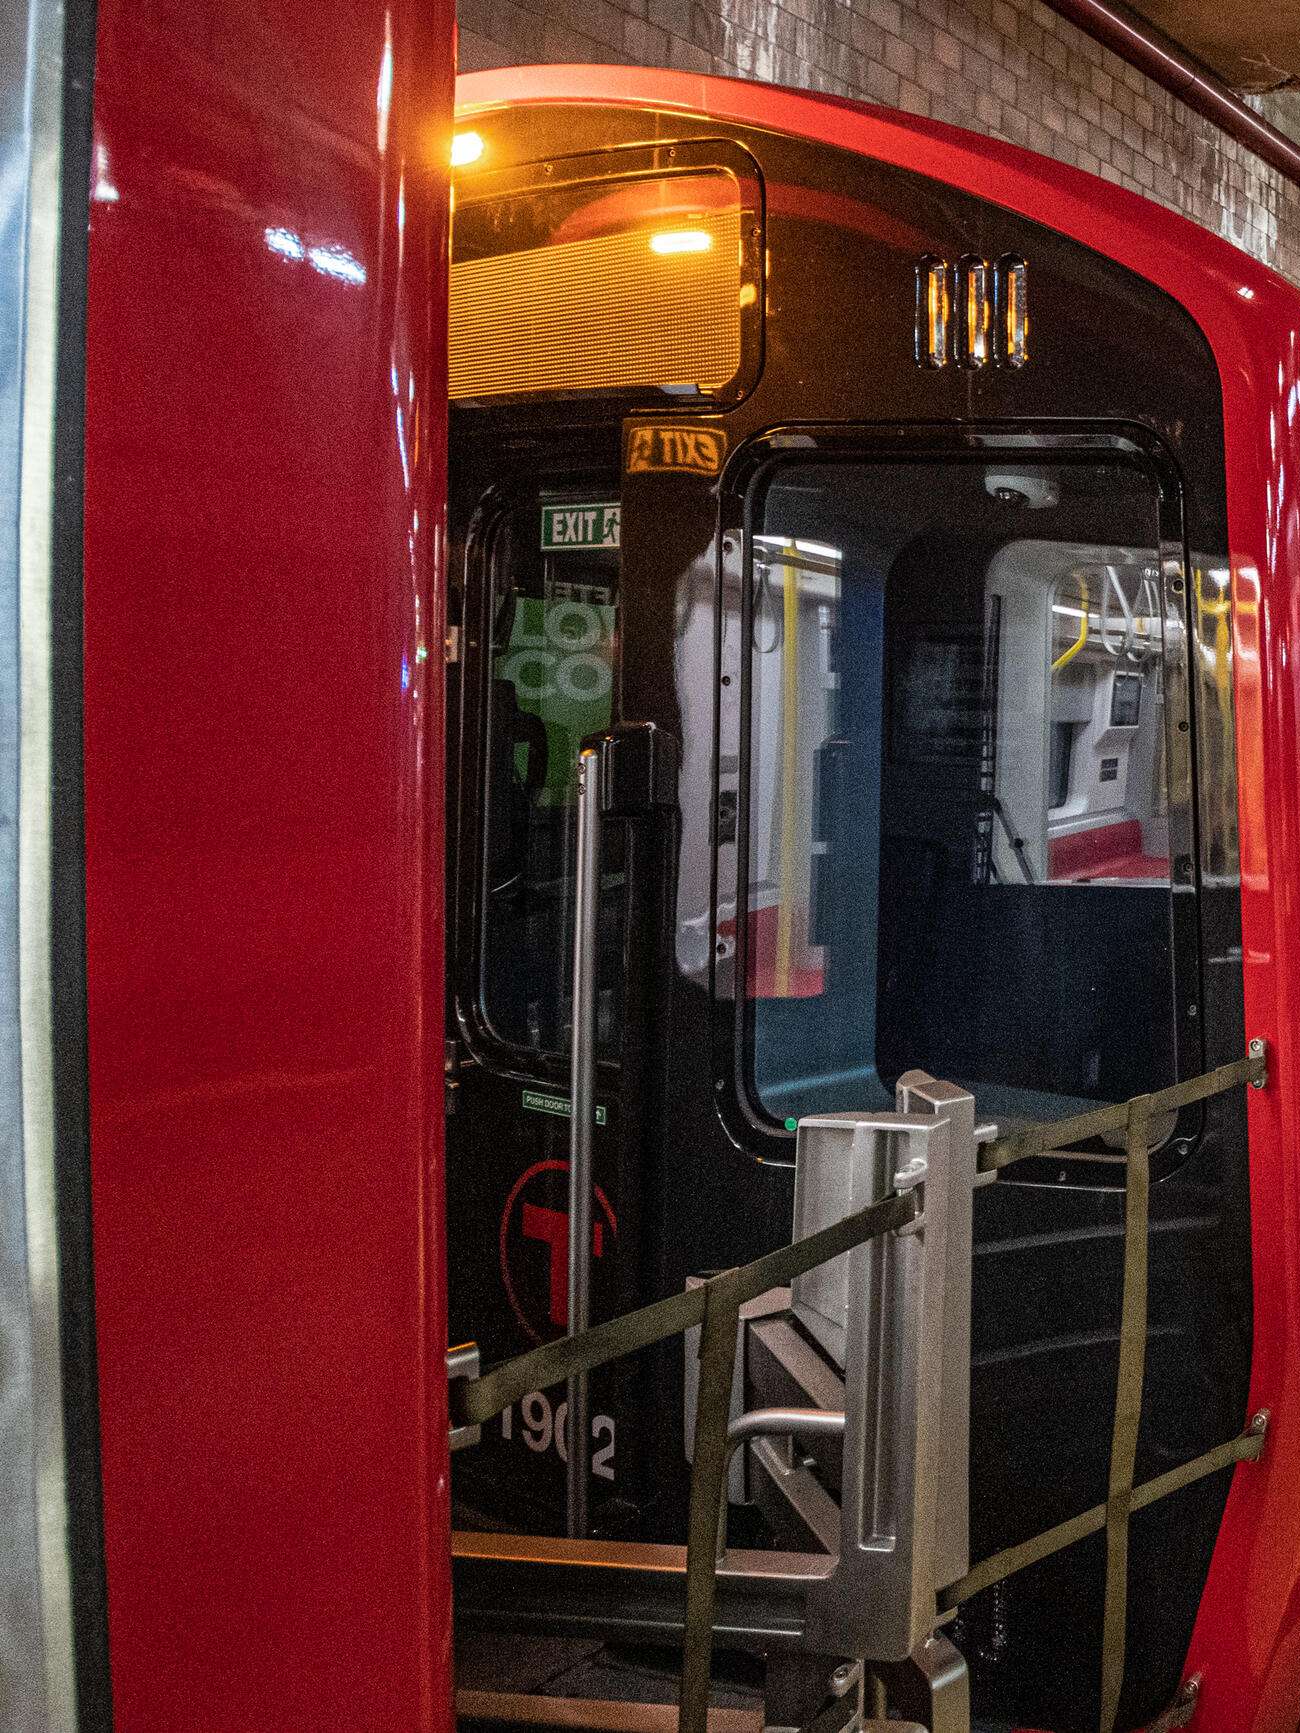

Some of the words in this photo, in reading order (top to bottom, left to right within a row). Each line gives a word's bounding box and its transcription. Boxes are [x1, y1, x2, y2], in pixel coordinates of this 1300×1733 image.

[552, 511, 597, 543] EXIT
[526, 1095, 544, 1106] PUSH
[544, 1099, 563, 1111] DOOR
